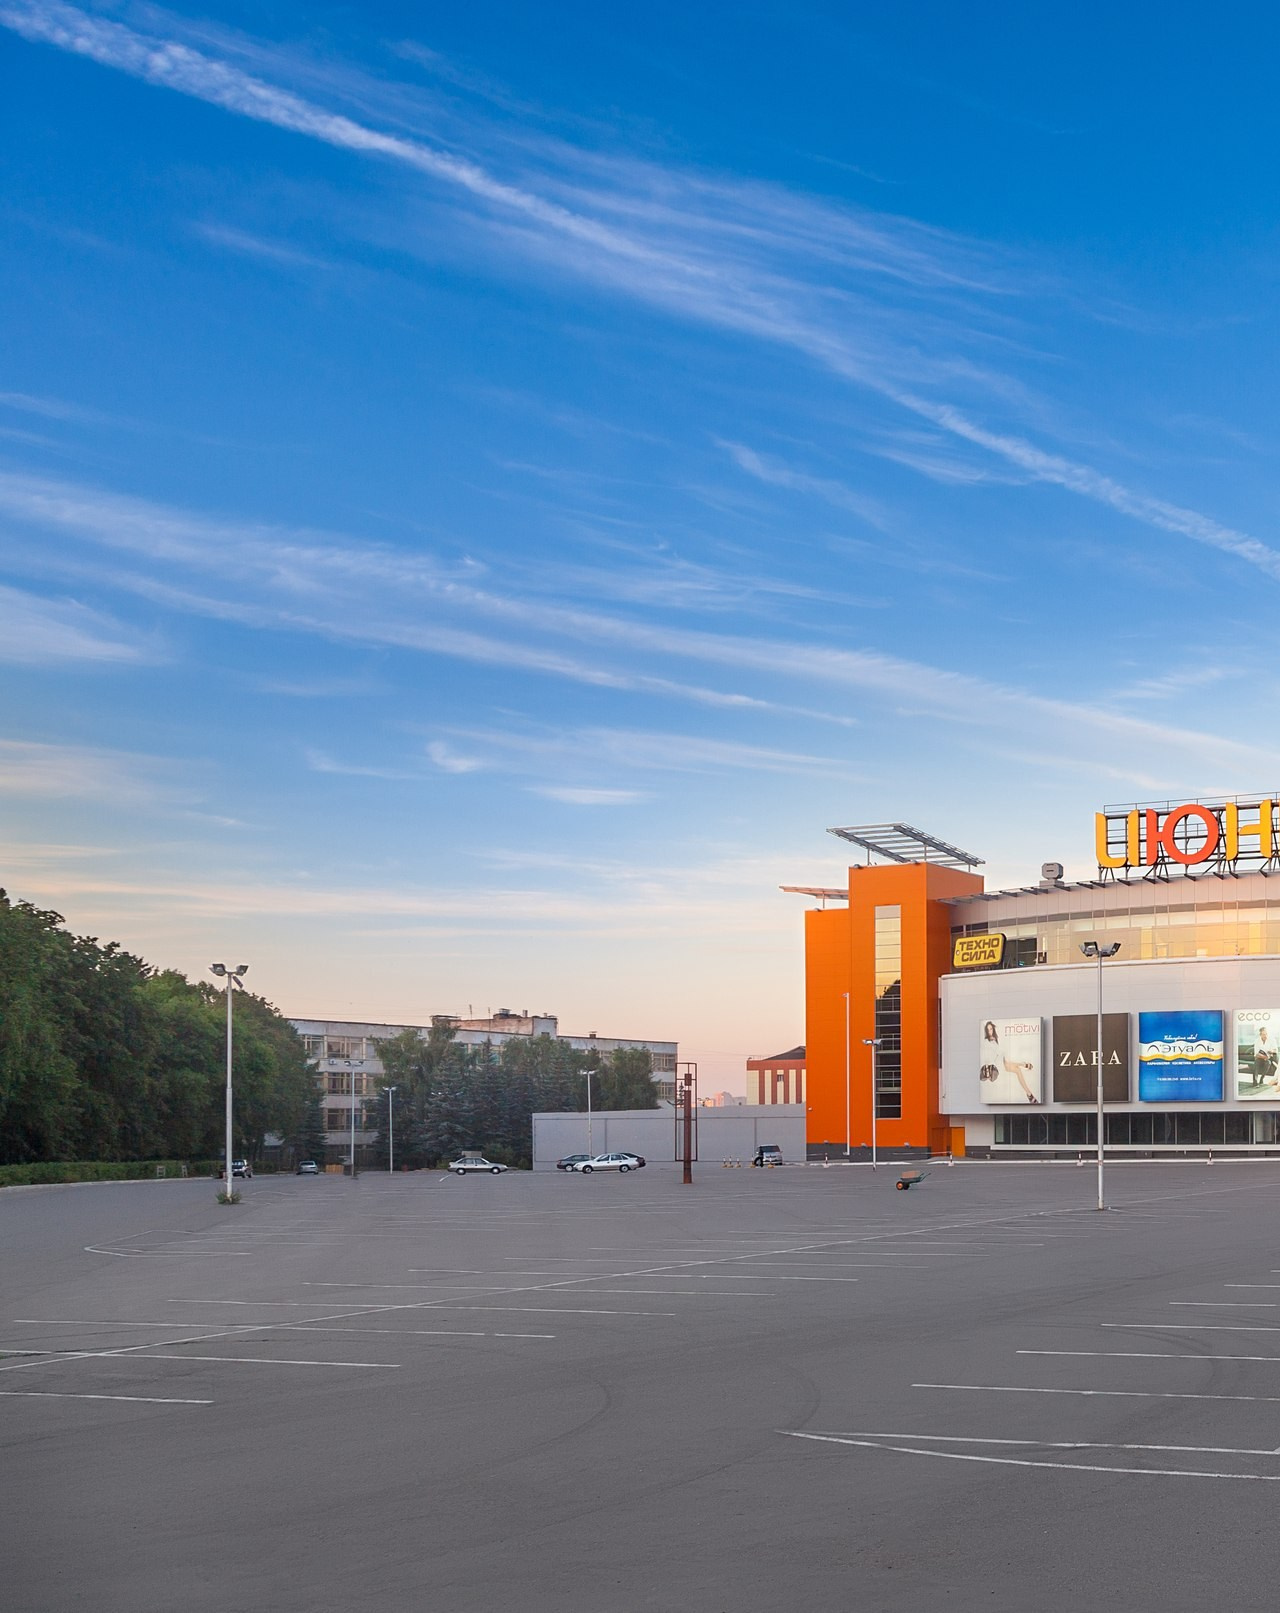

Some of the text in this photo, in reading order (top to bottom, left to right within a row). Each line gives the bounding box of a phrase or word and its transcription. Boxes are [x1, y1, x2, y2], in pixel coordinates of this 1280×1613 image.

[959, 938, 1000, 951] ТЕХНО
[961, 949, 996, 962] СИЛА
[1237, 1012, 1271, 1021] ecco
[1004, 1024, 1040, 1034] motivi
[1060, 1049, 1122, 1066] ZARA
